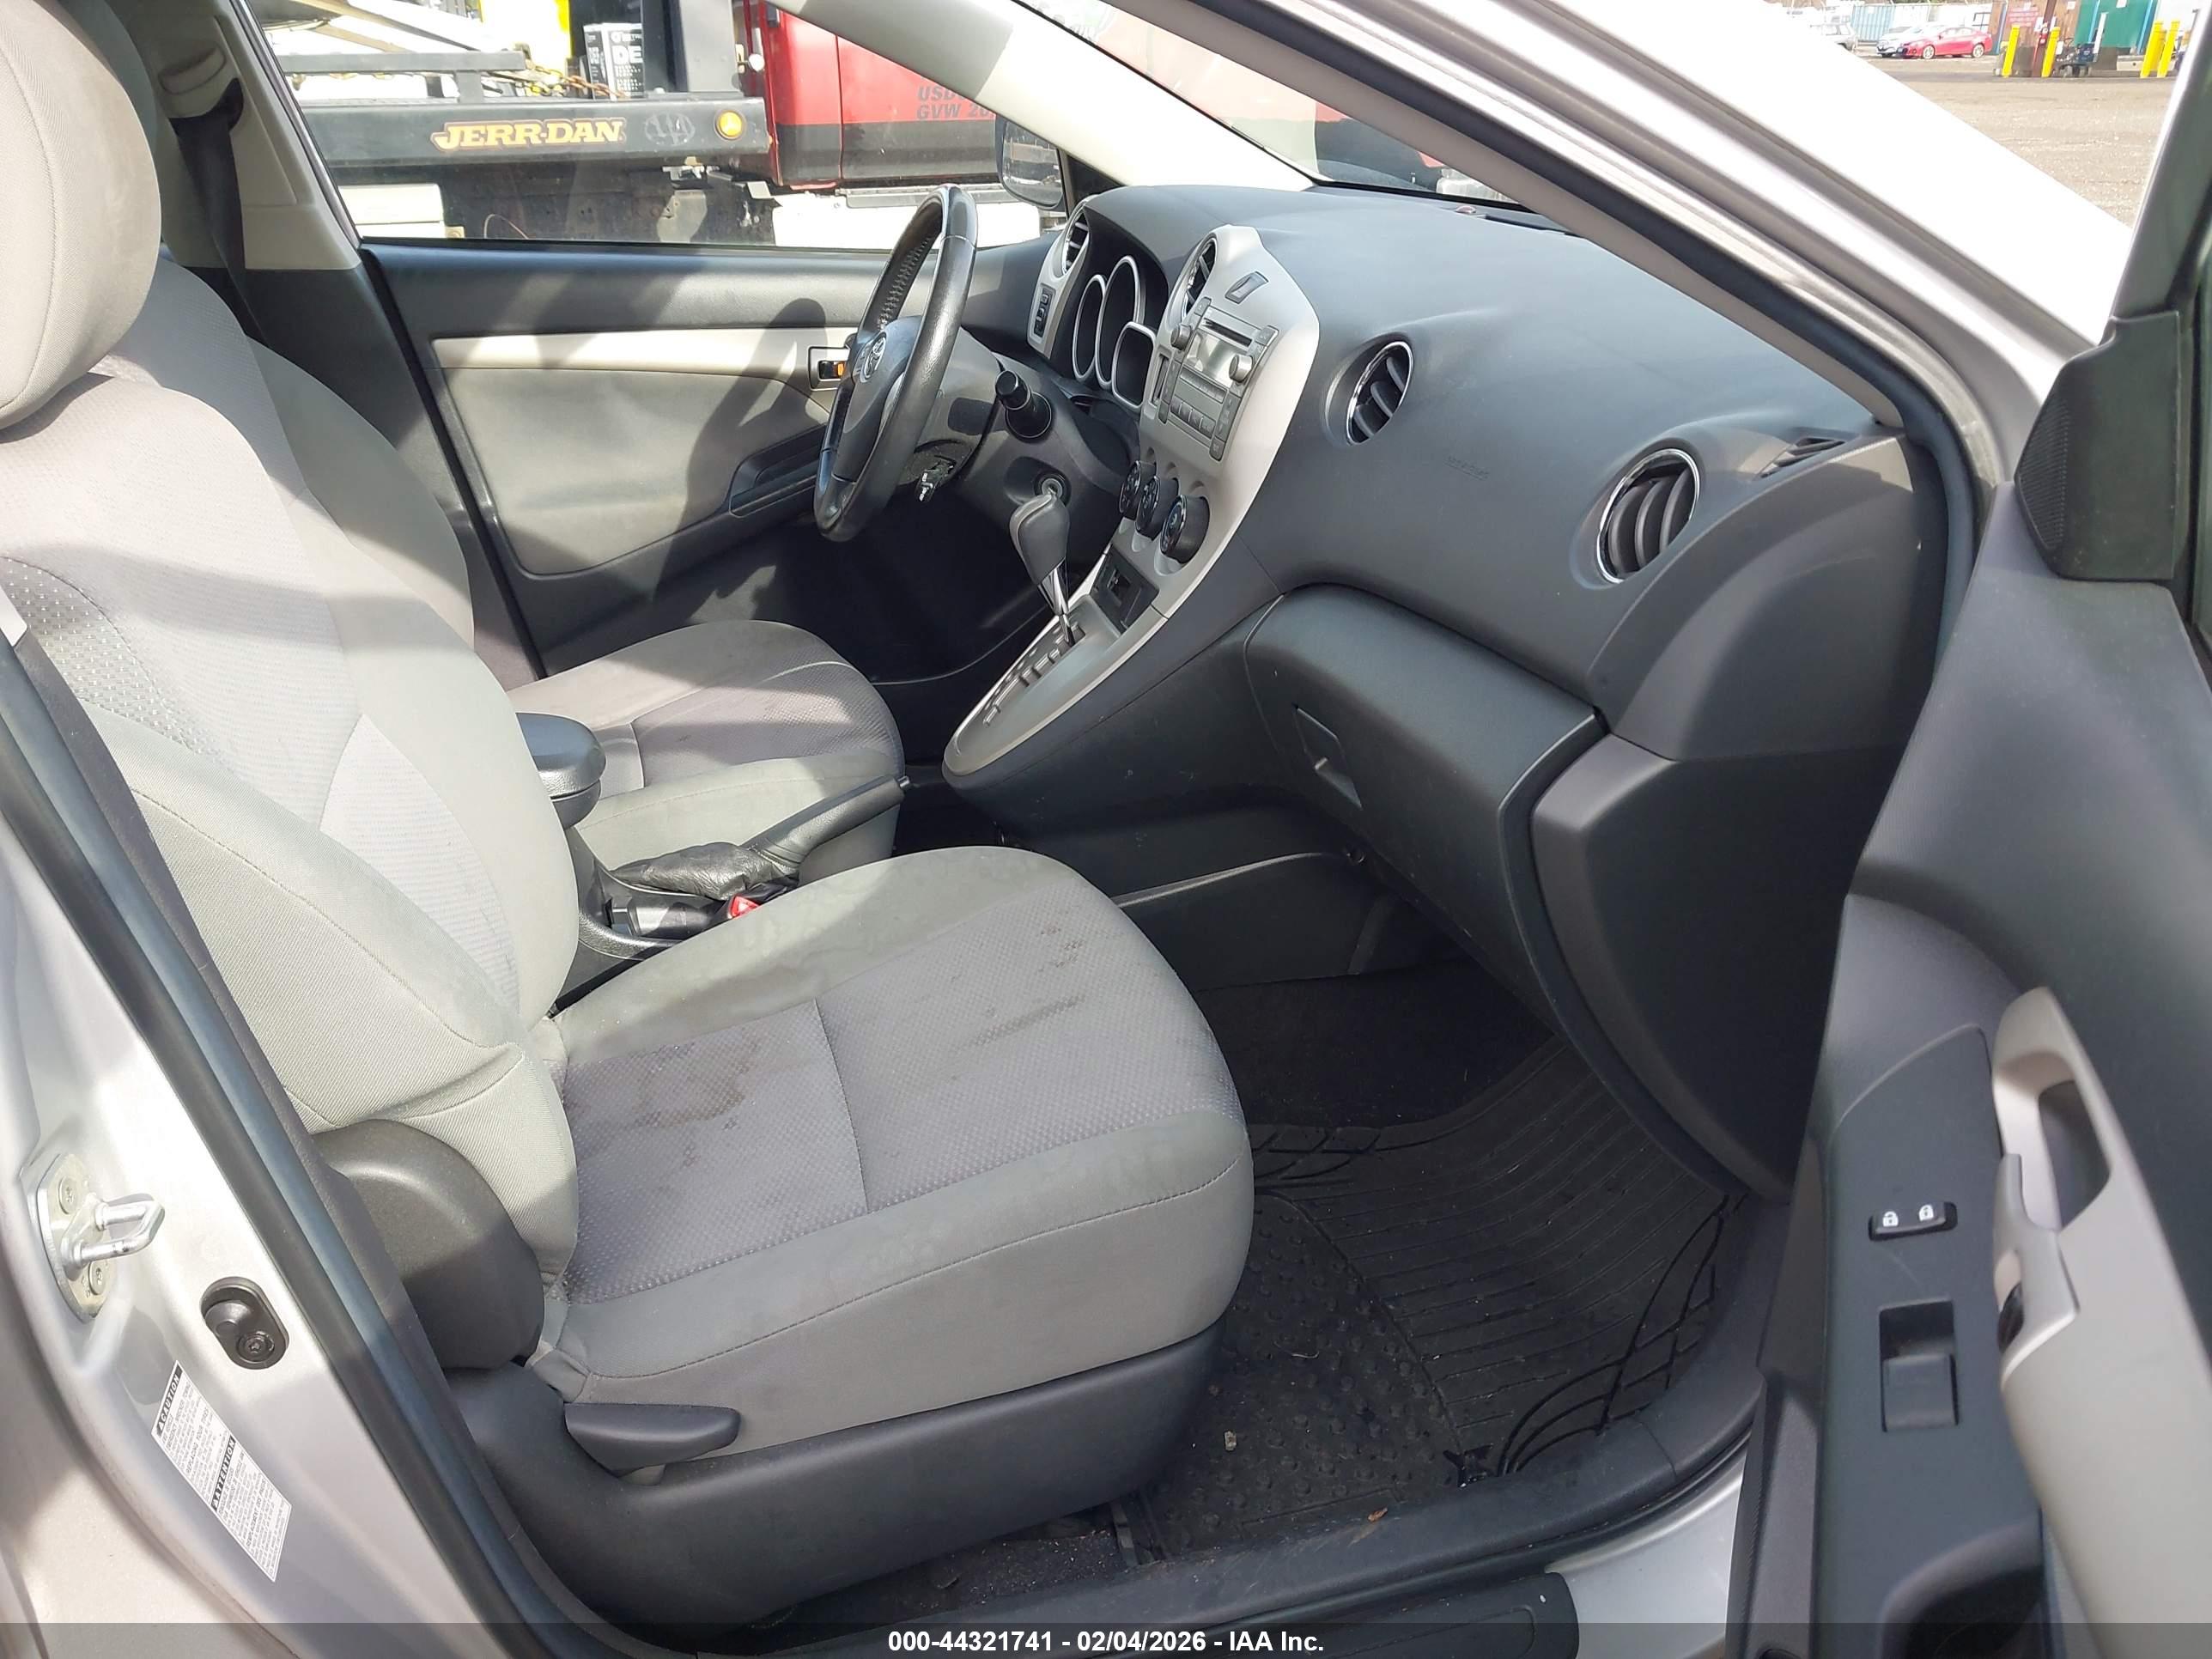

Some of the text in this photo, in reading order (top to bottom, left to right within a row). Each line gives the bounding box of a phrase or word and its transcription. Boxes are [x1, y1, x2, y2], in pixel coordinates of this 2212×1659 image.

[916, 102, 962, 119] GVW
[160, 1373, 179, 1423] CAUTION
[214, 1437, 234, 1500] ATTENTION
